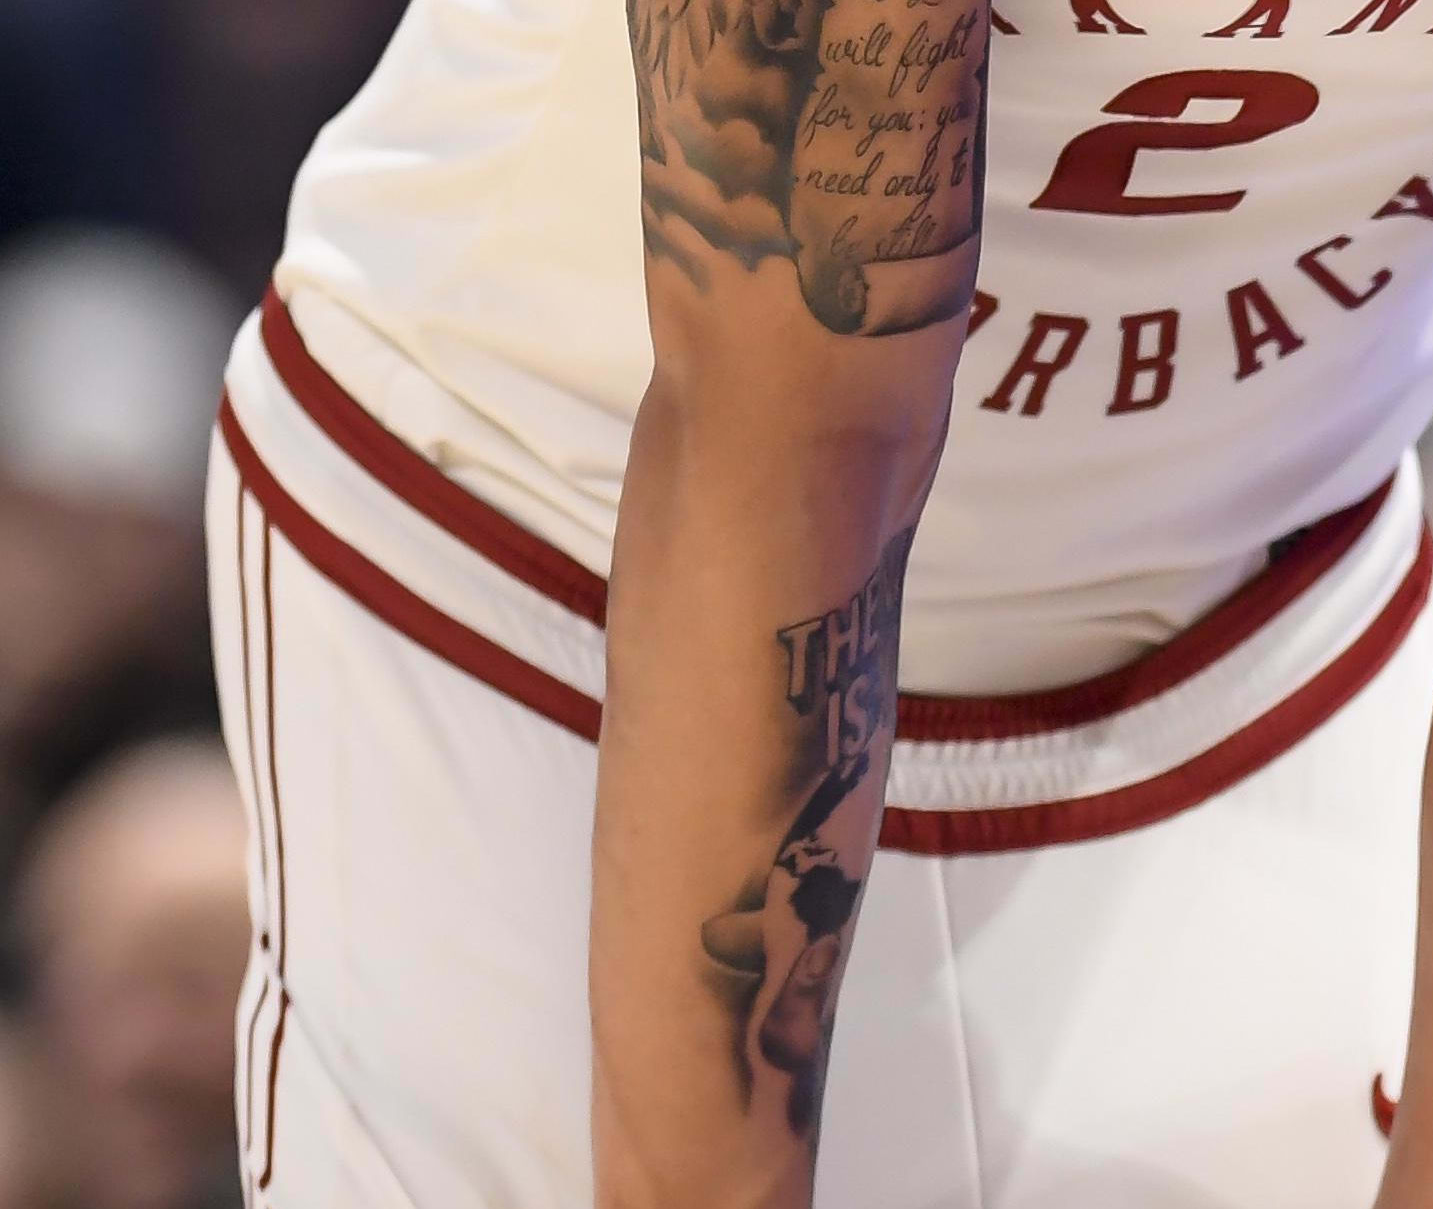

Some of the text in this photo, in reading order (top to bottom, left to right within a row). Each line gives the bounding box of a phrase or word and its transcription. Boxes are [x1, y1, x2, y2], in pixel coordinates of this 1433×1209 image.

[825, 9, 978, 98] will fight
[803, 84, 854, 149] for
[1029, 69, 1321, 216] 2
[806, 151, 884, 196] need
[884, 147, 940, 223] only
